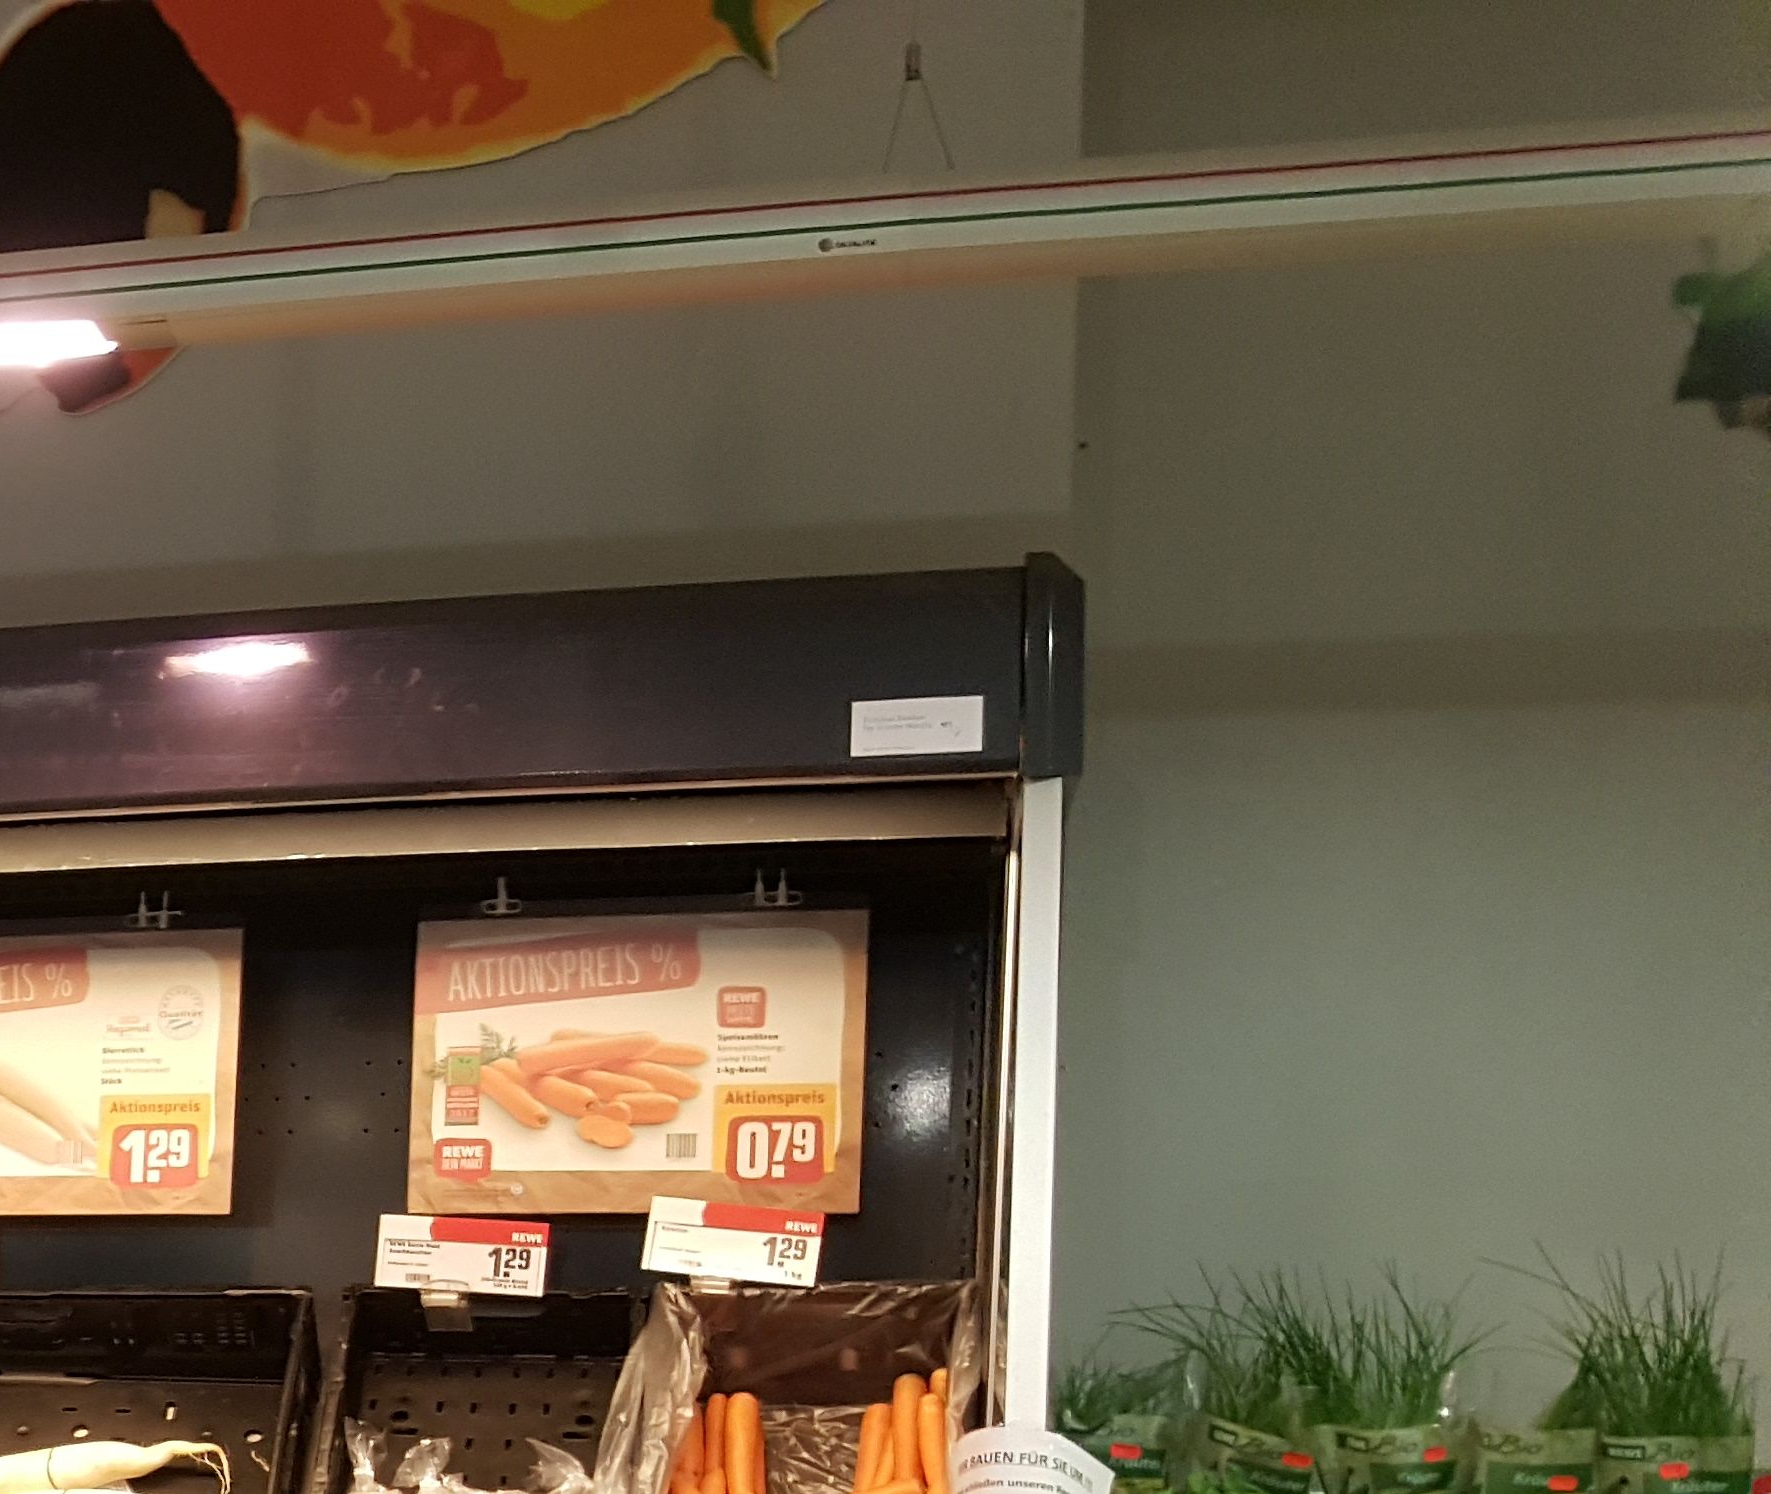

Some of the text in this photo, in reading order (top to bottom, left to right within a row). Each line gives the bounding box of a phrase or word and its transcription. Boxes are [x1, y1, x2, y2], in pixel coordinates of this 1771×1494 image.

[44, 963, 73, 999] %
[447, 943, 682, 1002] AKTIONSPREIS %
[725, 1089, 825, 1107] Aktionspreis
[110, 1101, 201, 1116] Aktionspreis
[119, 1128, 190, 1183] 1.29
[442, 1146, 484, 1158] REWE
[736, 1121, 816, 1179] 0.79
[785, 1220, 818, 1233] REWE
[512, 1232, 543, 1243] REWE
[763, 1236, 808, 1266] 1.29
[488, 1247, 532, 1278] 1.29
[1019, 1450, 1048, 1467] FÜR
[1007, 1480, 1054, 1492] unseren
